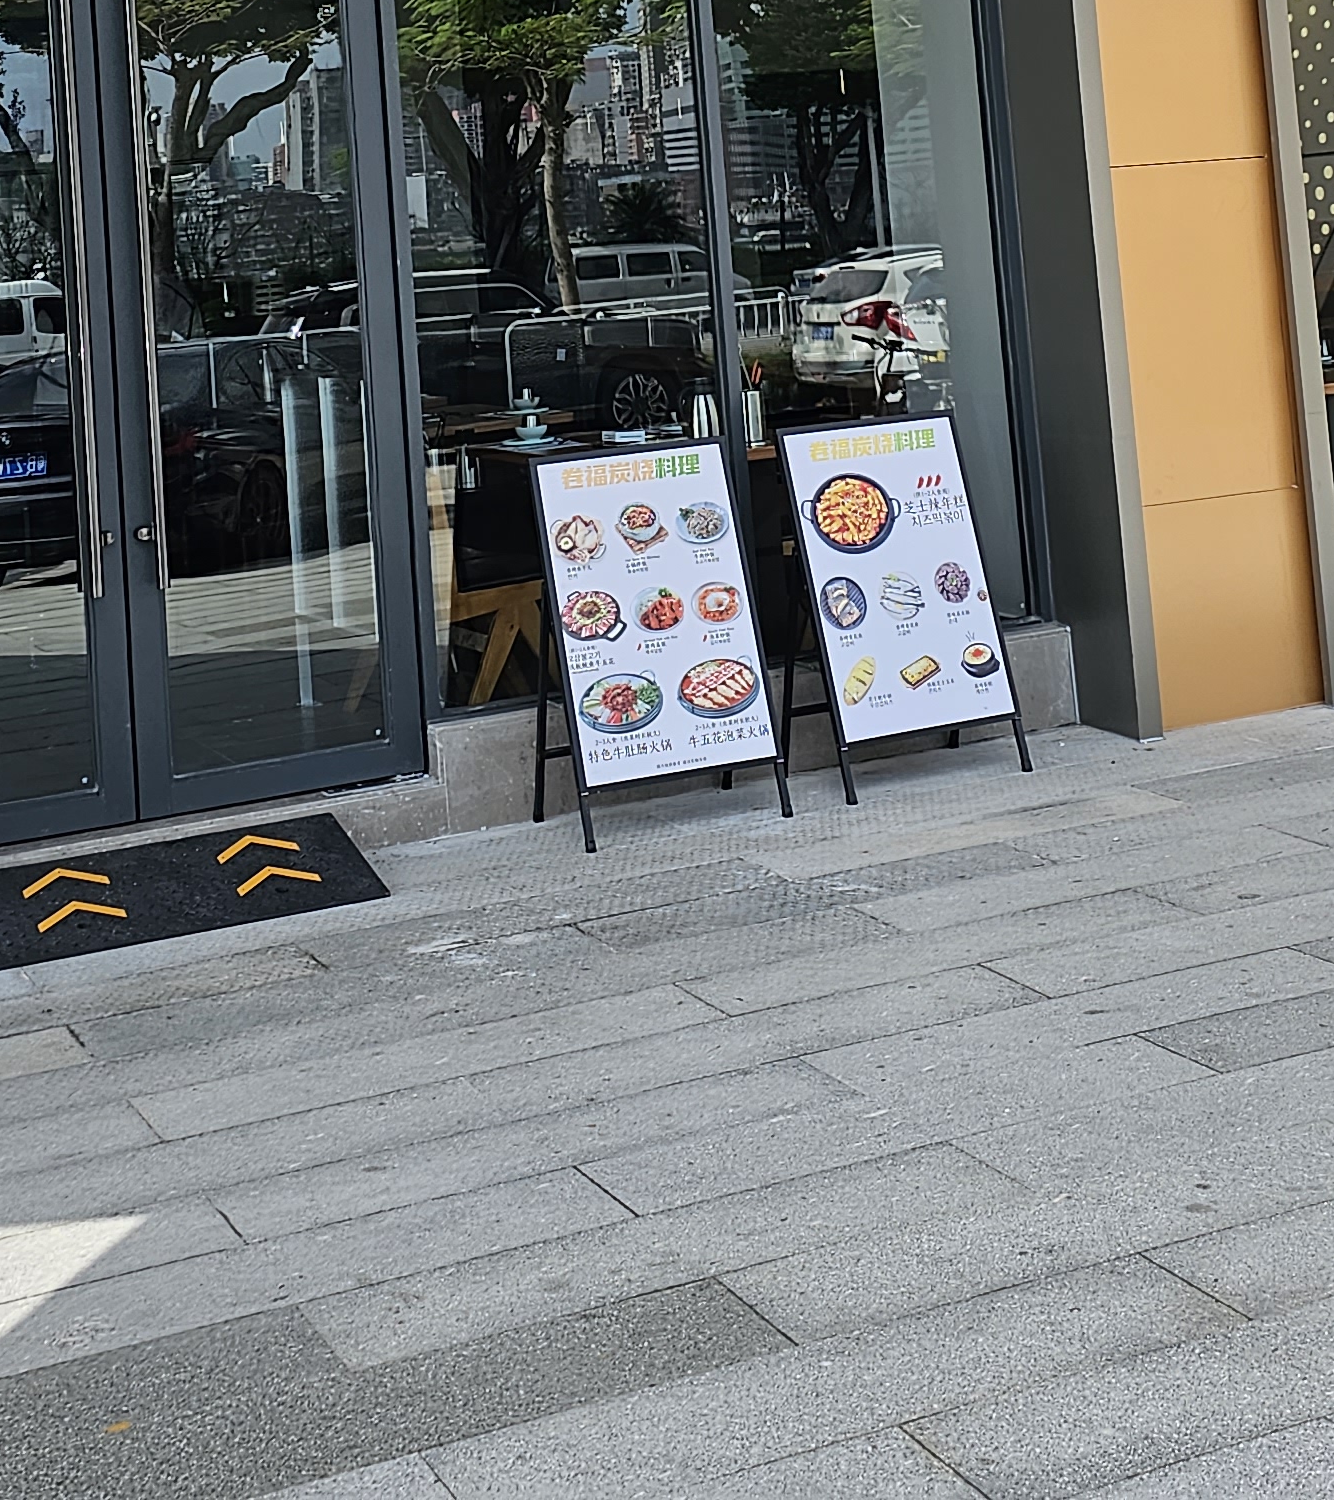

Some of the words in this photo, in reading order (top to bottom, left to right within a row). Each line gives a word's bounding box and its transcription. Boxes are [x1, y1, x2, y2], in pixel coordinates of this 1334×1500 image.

[809, 428, 936, 462] 卷福炭烧料理
[561, 453, 701, 490] 卷福炭烧料理
[688, 723, 770, 748] 牛五花泡菜火锅
